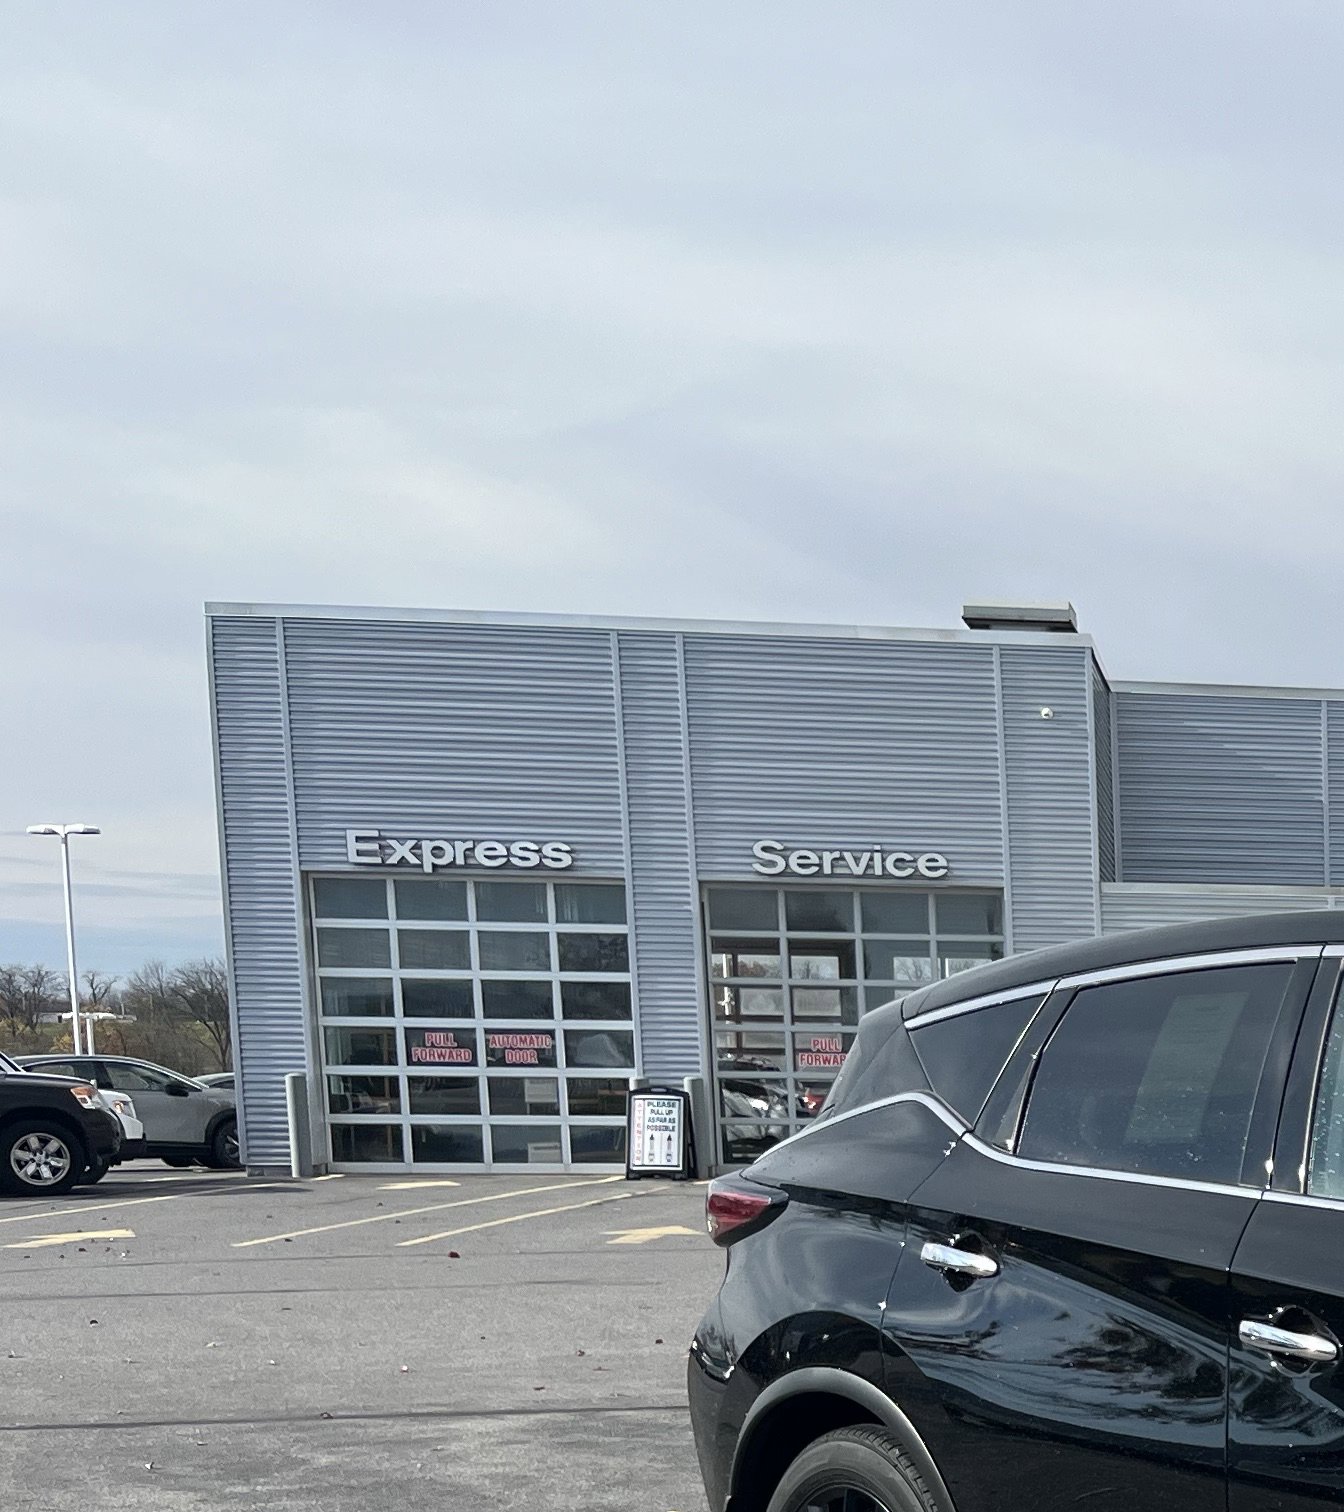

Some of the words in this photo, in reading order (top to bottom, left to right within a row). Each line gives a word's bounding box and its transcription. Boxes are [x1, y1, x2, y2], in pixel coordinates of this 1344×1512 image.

[345, 828, 574, 874] Express
[751, 839, 949, 878] Service
[424, 1032, 457, 1047] PULL
[489, 1034, 552, 1049] AUTOMATIC
[811, 1037, 842, 1052] PULL
[411, 1047, 473, 1063] FORWARD
[504, 1050, 539, 1064] DOOR
[799, 1052, 847, 1067] FORWAR
